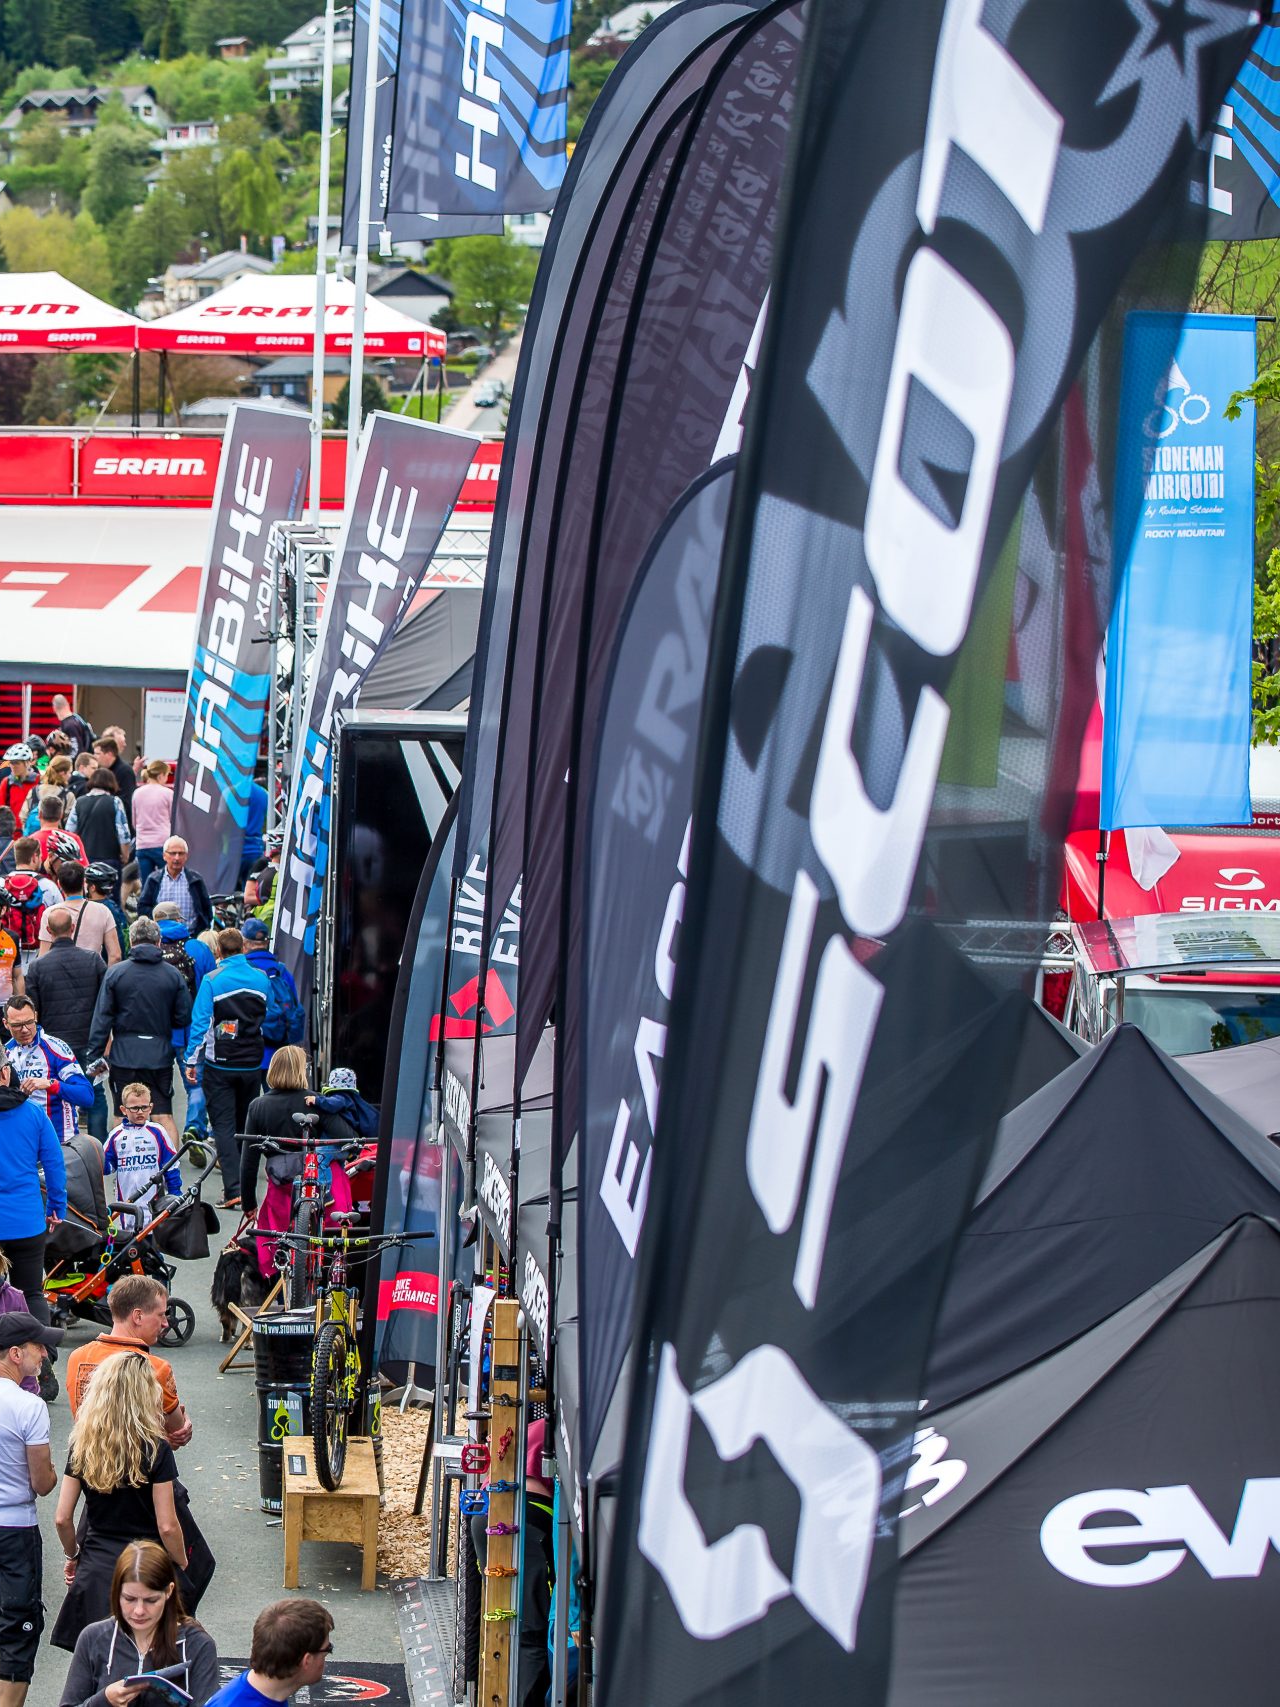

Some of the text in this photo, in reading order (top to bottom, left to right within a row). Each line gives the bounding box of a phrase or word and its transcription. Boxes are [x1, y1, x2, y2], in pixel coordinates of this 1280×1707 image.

[46, 332, 97, 342] SRAM
[176, 334, 227, 345] SRAM
[255, 335, 305, 346] SRAM
[1142, 446, 1224, 473] STONEMAN
[93, 458, 204, 476] SRAM
[1144, 528, 1225, 539] ROCKY MOUNTAIN
[116, 1154, 157, 1167] CERTUSS
[395, 1278, 413, 1291] BIKE
